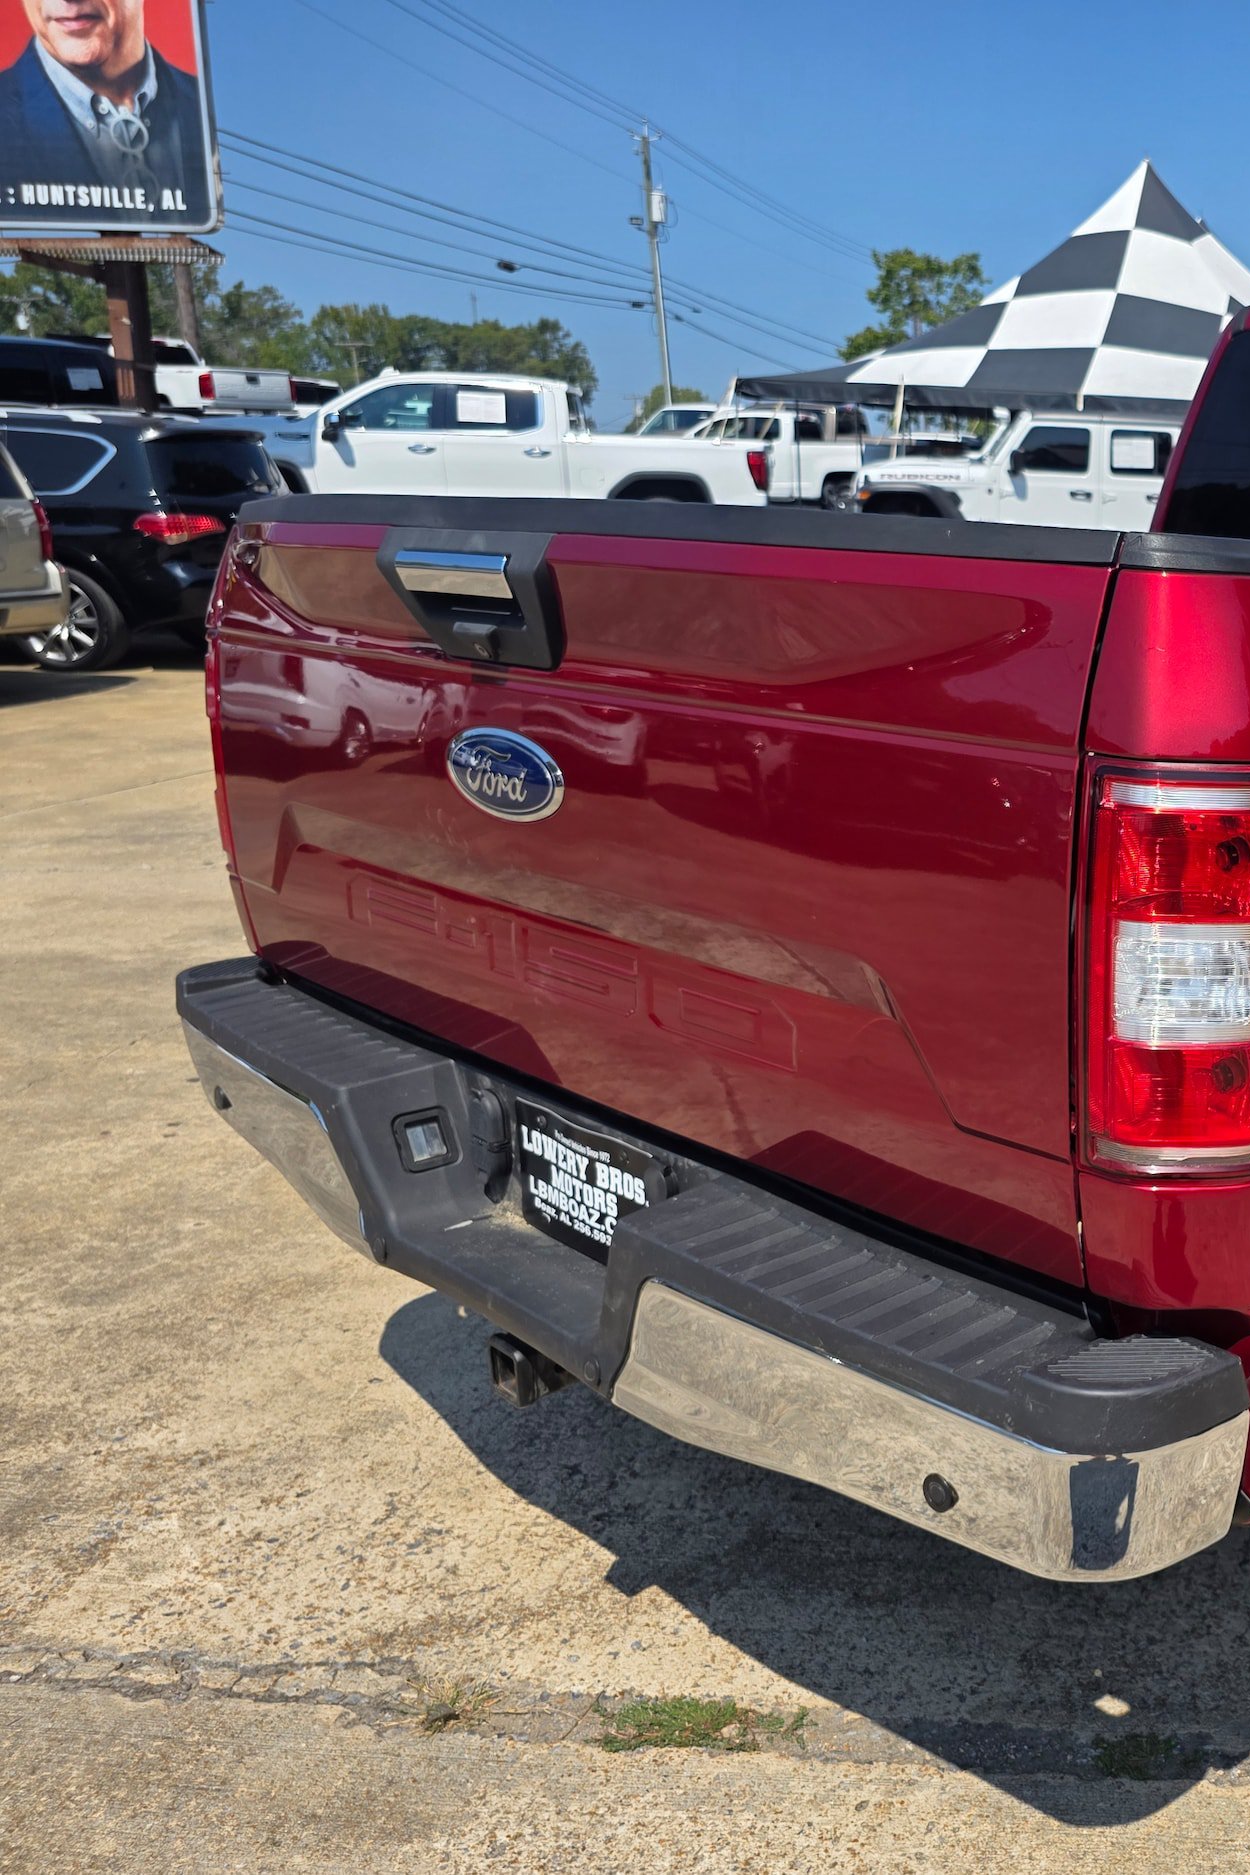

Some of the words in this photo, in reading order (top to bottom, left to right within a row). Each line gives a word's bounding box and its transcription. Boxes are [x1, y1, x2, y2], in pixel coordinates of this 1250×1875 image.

[21, 184, 155, 212] HUNTSVILLE,
[162, 189, 187, 210] AL
[880, 473, 961, 481] RUBICON
[465, 744, 528, 804] Ford
[521, 1124, 589, 1181] LOWERY
[551, 1164, 618, 1218] MOTORS
[560, 1211, 573, 1227] AL
